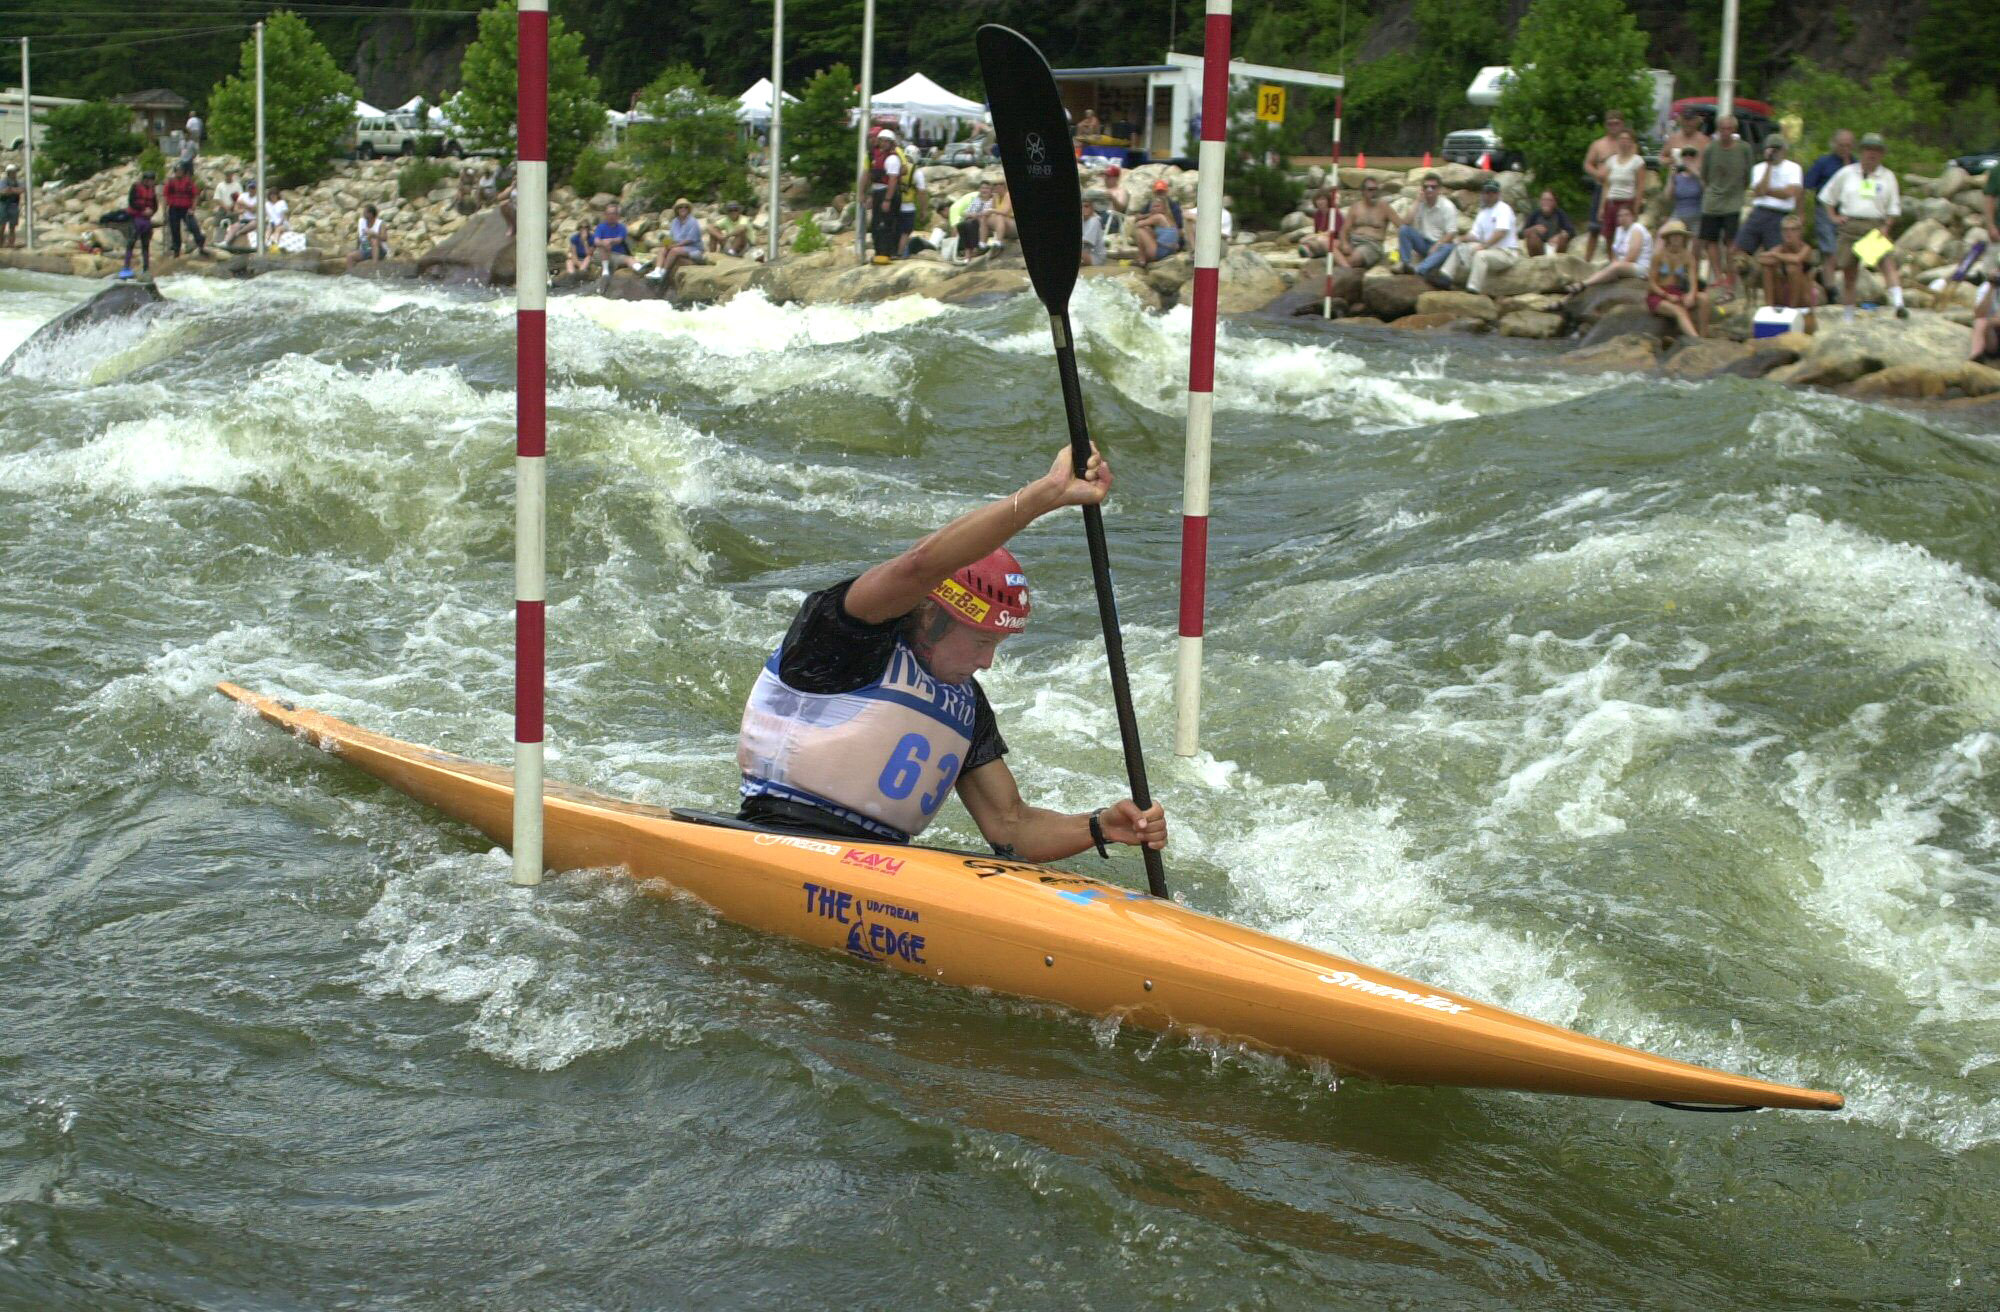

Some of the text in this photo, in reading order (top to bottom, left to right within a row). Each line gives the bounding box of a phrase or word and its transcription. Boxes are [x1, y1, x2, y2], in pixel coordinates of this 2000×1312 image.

[878, 732, 960, 816] 63
[779, 835, 842, 856] mazda
[843, 848, 906, 872] KAVU
[802, 881, 854, 925] THE
[869, 922, 927, 965] EDGE
